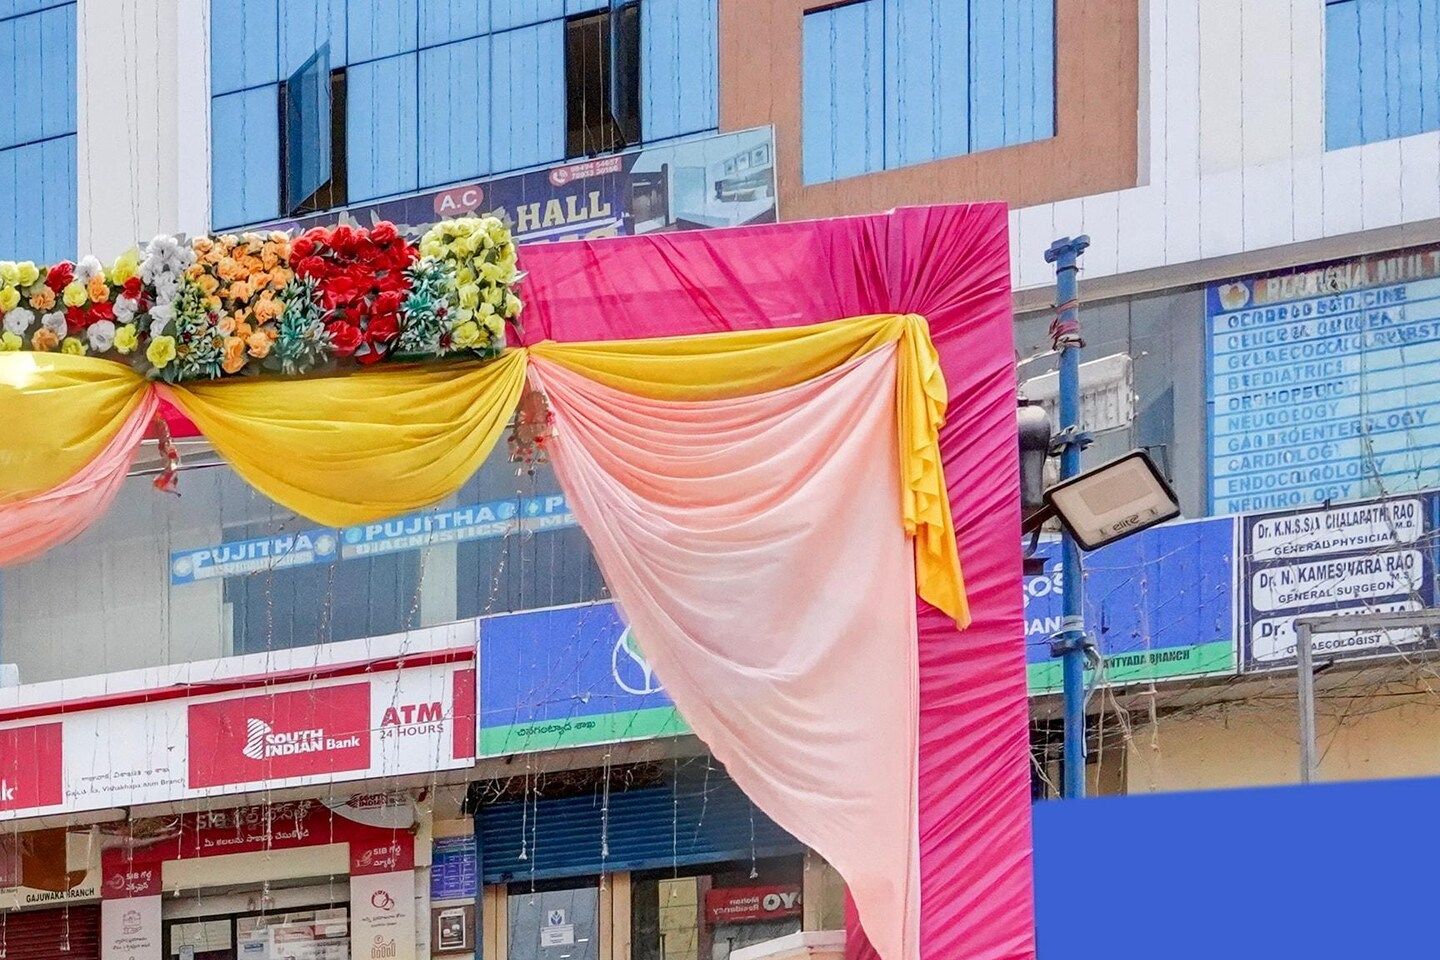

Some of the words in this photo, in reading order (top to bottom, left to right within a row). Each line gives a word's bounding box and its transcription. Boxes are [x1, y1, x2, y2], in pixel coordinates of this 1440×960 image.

[440, 190, 477, 211] A.C
[517, 191, 611, 232] HALL
[365, 506, 496, 541] PUJITHA
[1258, 524, 1271, 539] Dr.
[1393, 503, 1414, 520] RAO
[192, 535, 313, 572] PUJITHA
[1281, 571, 1294, 585] N.
[1387, 554, 1414, 572] RAO
[1278, 589, 1333, 604] GENERAL
[1262, 622, 1286, 638] Dr.
[381, 702, 442, 727] ATM
[266, 729, 323, 745] SOUTH
[380, 730, 393, 740] 24
[397, 723, 444, 738] HOURS
[266, 739, 323, 757] INDIAN
[327, 736, 360, 750] Bank
[373, 847, 387, 855] SIB
[26, 891, 65, 903] GAJUWAKA
